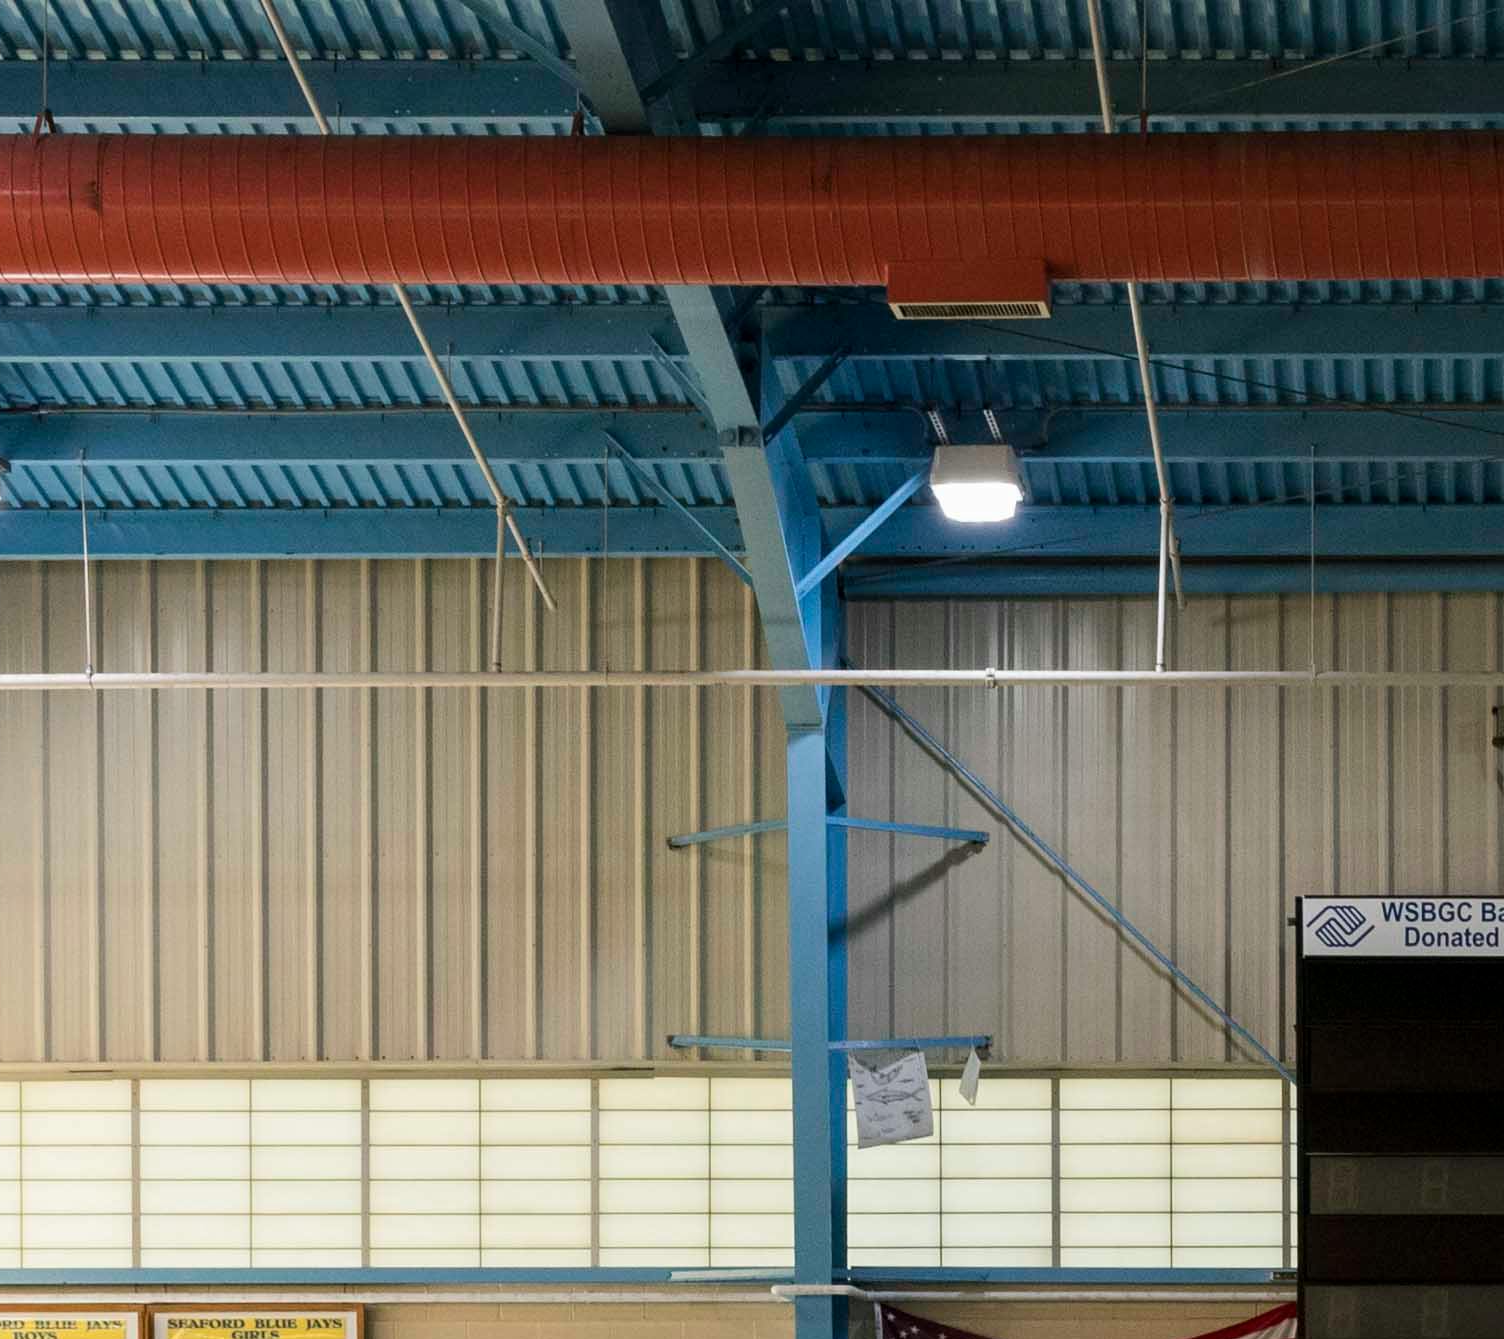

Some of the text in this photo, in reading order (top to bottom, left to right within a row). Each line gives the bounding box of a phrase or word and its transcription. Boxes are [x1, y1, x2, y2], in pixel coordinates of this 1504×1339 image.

[1381, 902, 1473, 922] WSBGC
[1404, 927, 1499, 948] Donated
[35, 1319, 78, 1330] BLUE
[86, 1319, 123, 1332] JAYS
[167, 1318, 343, 1330] SEAFORD BLUE JAYS
[232, 1330, 280, 1339] GIRLS
